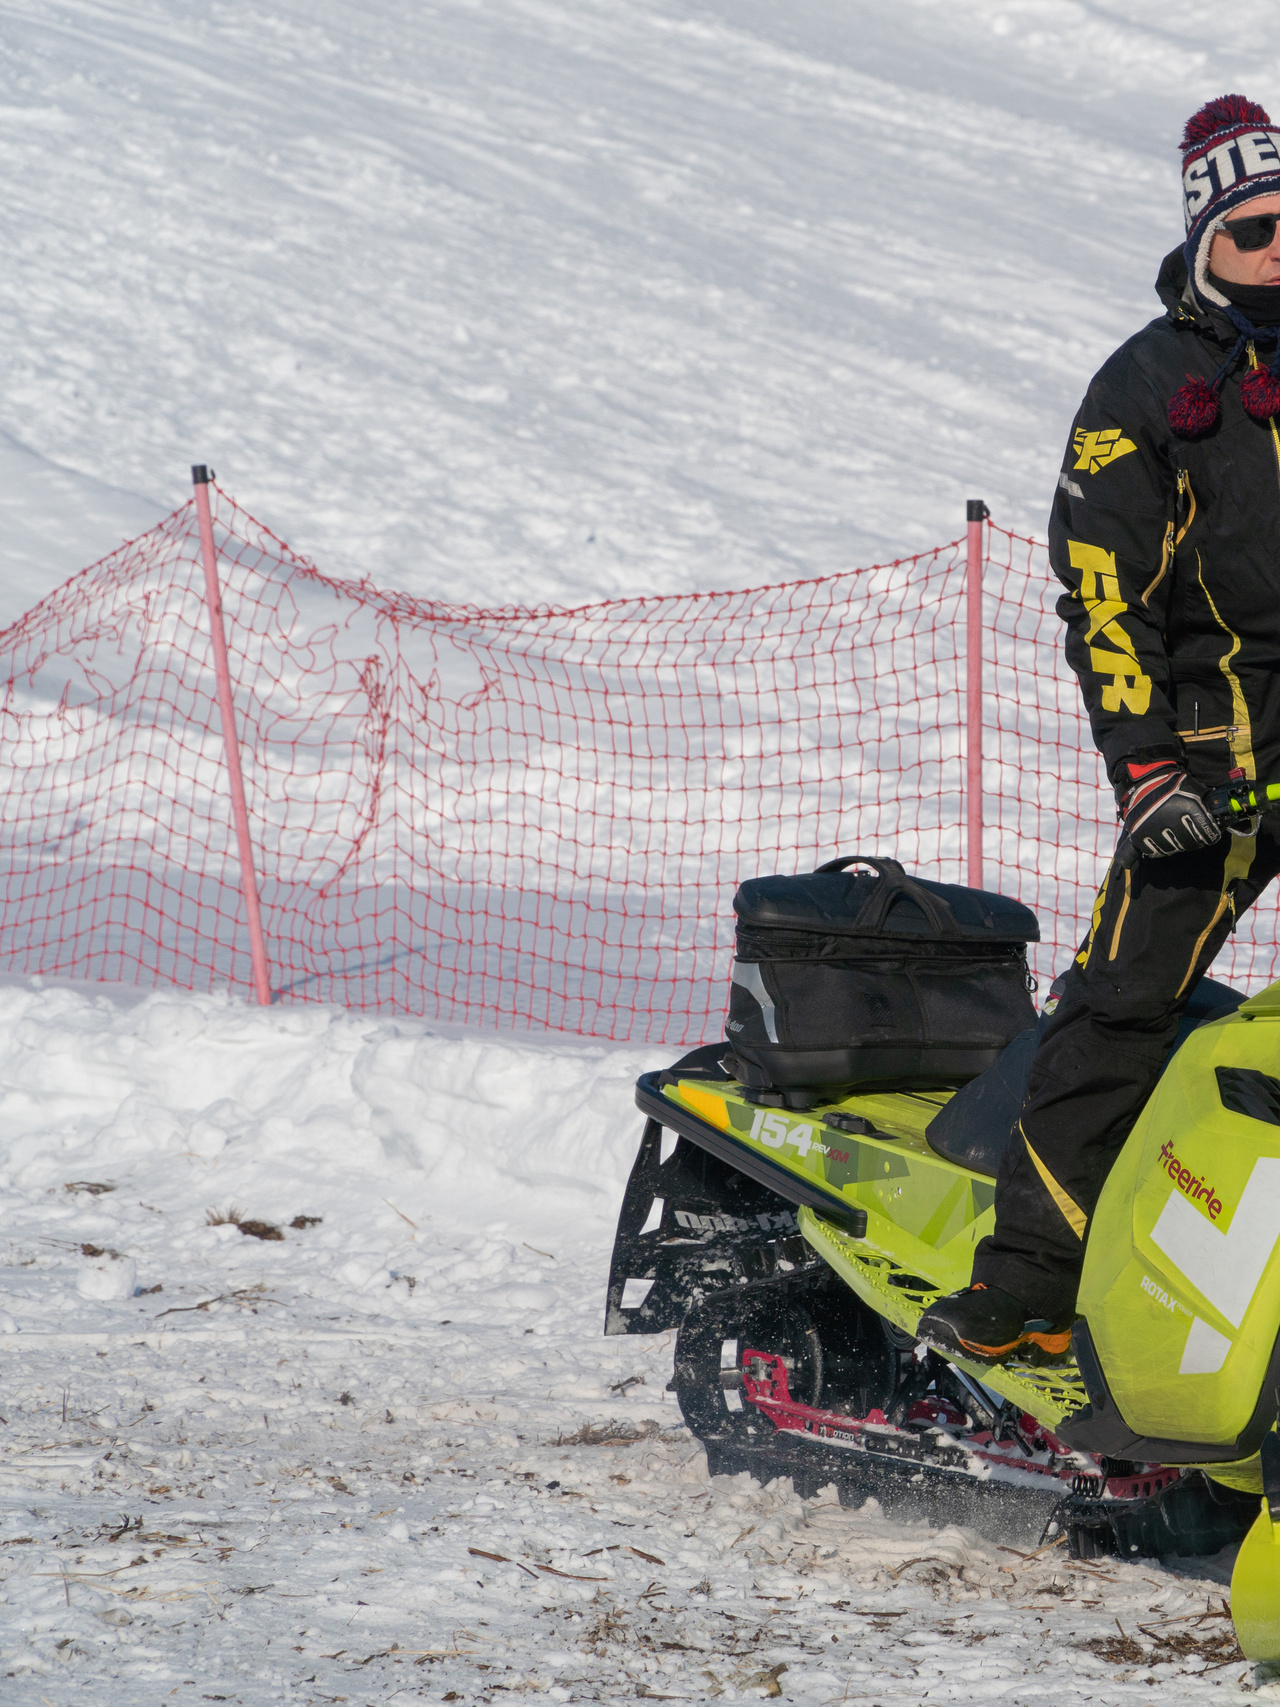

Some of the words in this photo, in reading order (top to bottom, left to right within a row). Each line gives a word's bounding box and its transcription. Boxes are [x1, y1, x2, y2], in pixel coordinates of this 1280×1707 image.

[1067, 539, 1153, 716] FXR
[749, 1109, 814, 1158] 154
[1157, 1139, 1223, 1220] freeride
[1140, 1275, 1178, 1313] ROTAX
